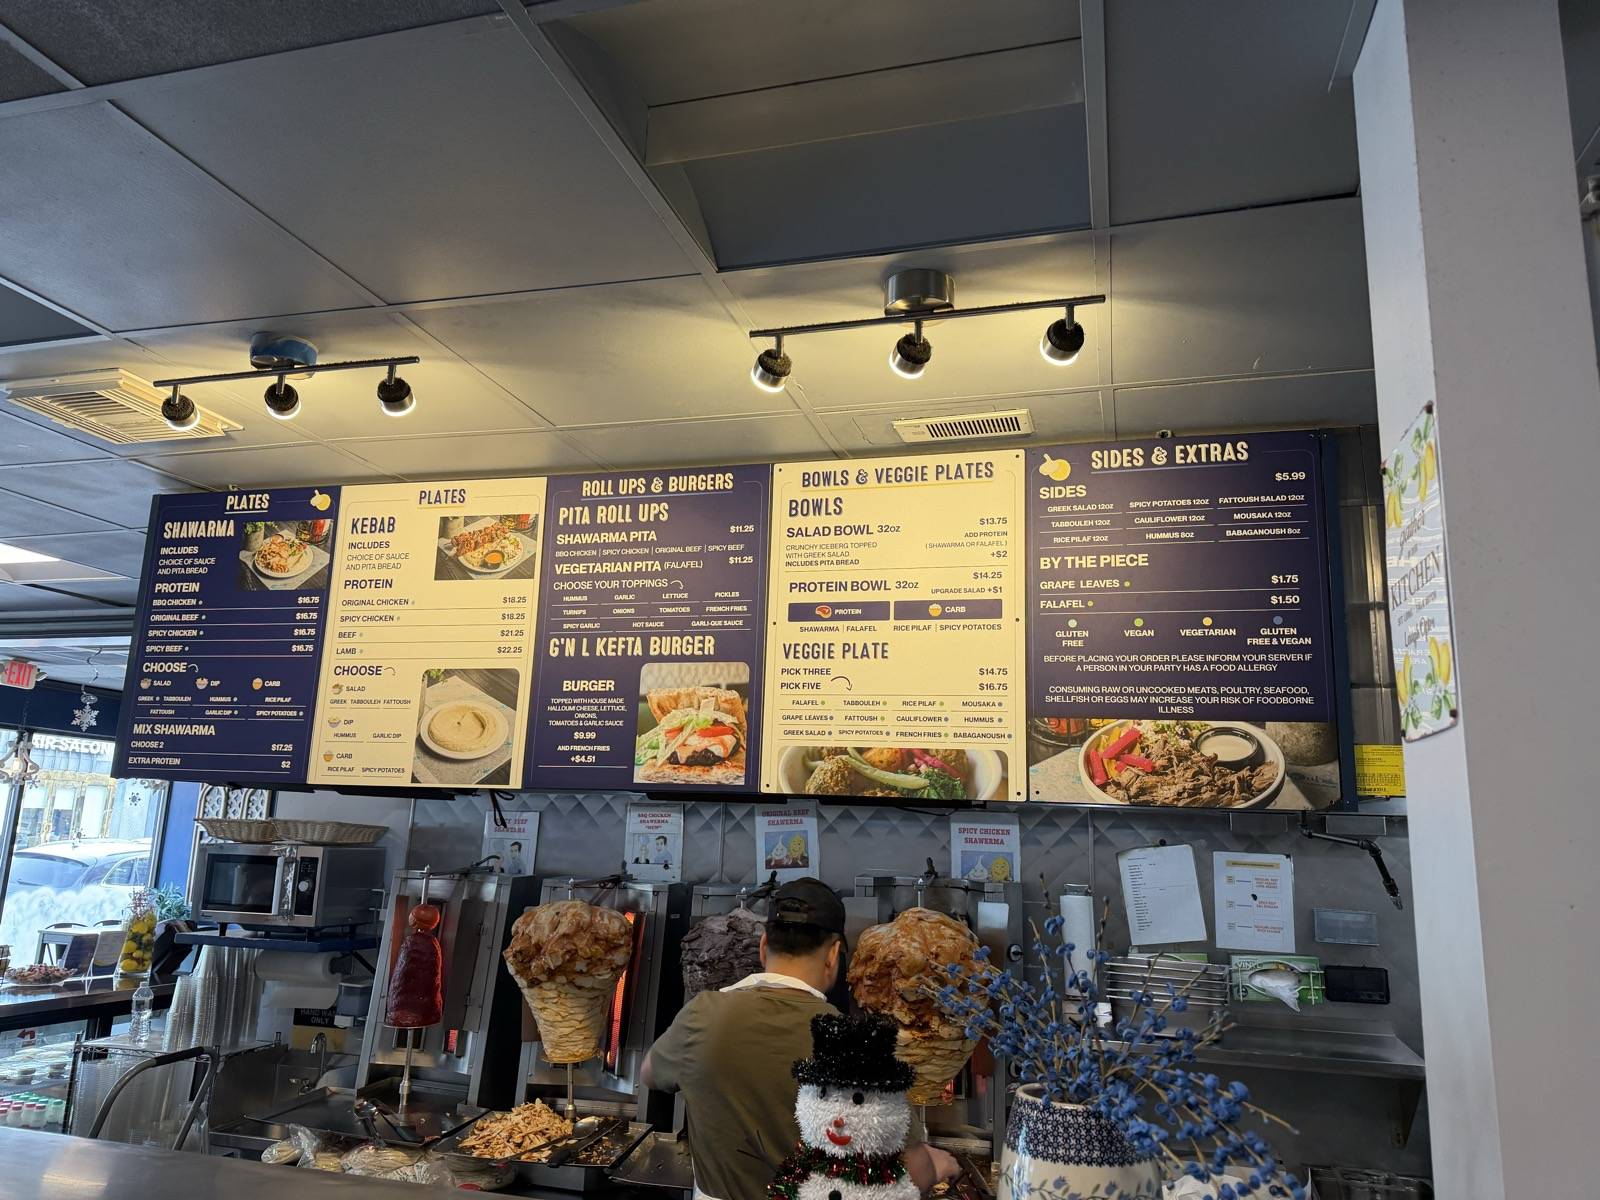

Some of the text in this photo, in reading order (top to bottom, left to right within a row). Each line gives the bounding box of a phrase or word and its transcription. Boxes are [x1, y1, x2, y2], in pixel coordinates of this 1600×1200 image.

[1091, 442, 1249, 470] SIDES & EXTRAS
[801, 462, 994, 488] BOWLS & VEGGIE PLATES
[1275, 472, 1306, 482] $5.99
[582, 473, 734, 497] ROLL UPS & BURGERS
[419, 489, 466, 505] PLATES
[1039, 485, 1087, 499] SIDES
[226, 494, 270, 510] PLATES
[788, 497, 843, 517] BOWLS
[559, 503, 669, 525] PITA ROLL UPS
[351, 516, 395, 534] KEBAB
[979, 517, 1008, 525] $13.75
[164, 520, 235, 539] SHAWARMA
[730, 525, 754, 534] $11.25
[787, 525, 900, 537] SALAD BOWL 32oz
[557, 531, 657, 544] SHAWARMA PITA
[348, 541, 390, 549] INCLUDES
[160, 547, 198, 555] INCLUDES
[729, 556, 753, 564] $11.25
[1040, 554, 1149, 569] BY THE PIECE
[555, 561, 703, 574] VEGETARIAN PITA (FALAFEL)
[973, 571, 1002, 580] $14.25
[1271, 574, 1299, 584] $1.75
[1390, 546, 1440, 611] KITCHEN
[155, 582, 199, 593] PROTEIN
[344, 579, 393, 589] PROTEIN
[554, 579, 668, 590] CHOOSE YOUR TOPPINGS
[789, 580, 919, 593] PROTEIN BOWL 32oz
[1040, 579, 1120, 590] GRAPE LEAVES
[987, 586, 1003, 594] +$1
[1040, 600, 1085, 608] FALAFEL
[1270, 595, 1300, 604] $1.50
[1055, 630, 1088, 638] GLUTEN
[1124, 629, 1154, 637] VEGAN
[1180, 628, 1236, 636] VEGETARIAN
[582, 638, 590, 657] L
[596, 637, 642, 657] KEFTA
[650, 636, 715, 656] BURGER
[1247, 638, 1270, 646] FREE
[1280, 637, 1312, 645] VEGAN
[783, 642, 889, 660] VEGGIE PLATE
[1078, 654, 1114, 662] PLACING
[1114, 654, 1138, 662] YOUR
[1140, 654, 1170, 662] ORDER
[1171, 654, 1205, 662] PLEASE
[1206, 654, 1241, 662] INFORM
[1242, 654, 1266, 662] YOUR
[1267, 654, 1304, 662] SERVER
[1304, 653, 1312, 661] IF
[143, 662, 187, 673] CHOOSE
[334, 665, 382, 676] CHOOSE
[979, 667, 1008, 676] $14.75
[7, 660, 33, 688] EXIT
[563, 680, 615, 691] BURGER
[780, 682, 1008, 691] PICK FIVE $16.75
[133, 724, 215, 736] MIX SHAWARMA
[281, 761, 290, 769] $2
[958, 827, 1010, 836] SPICY CHICKEN
